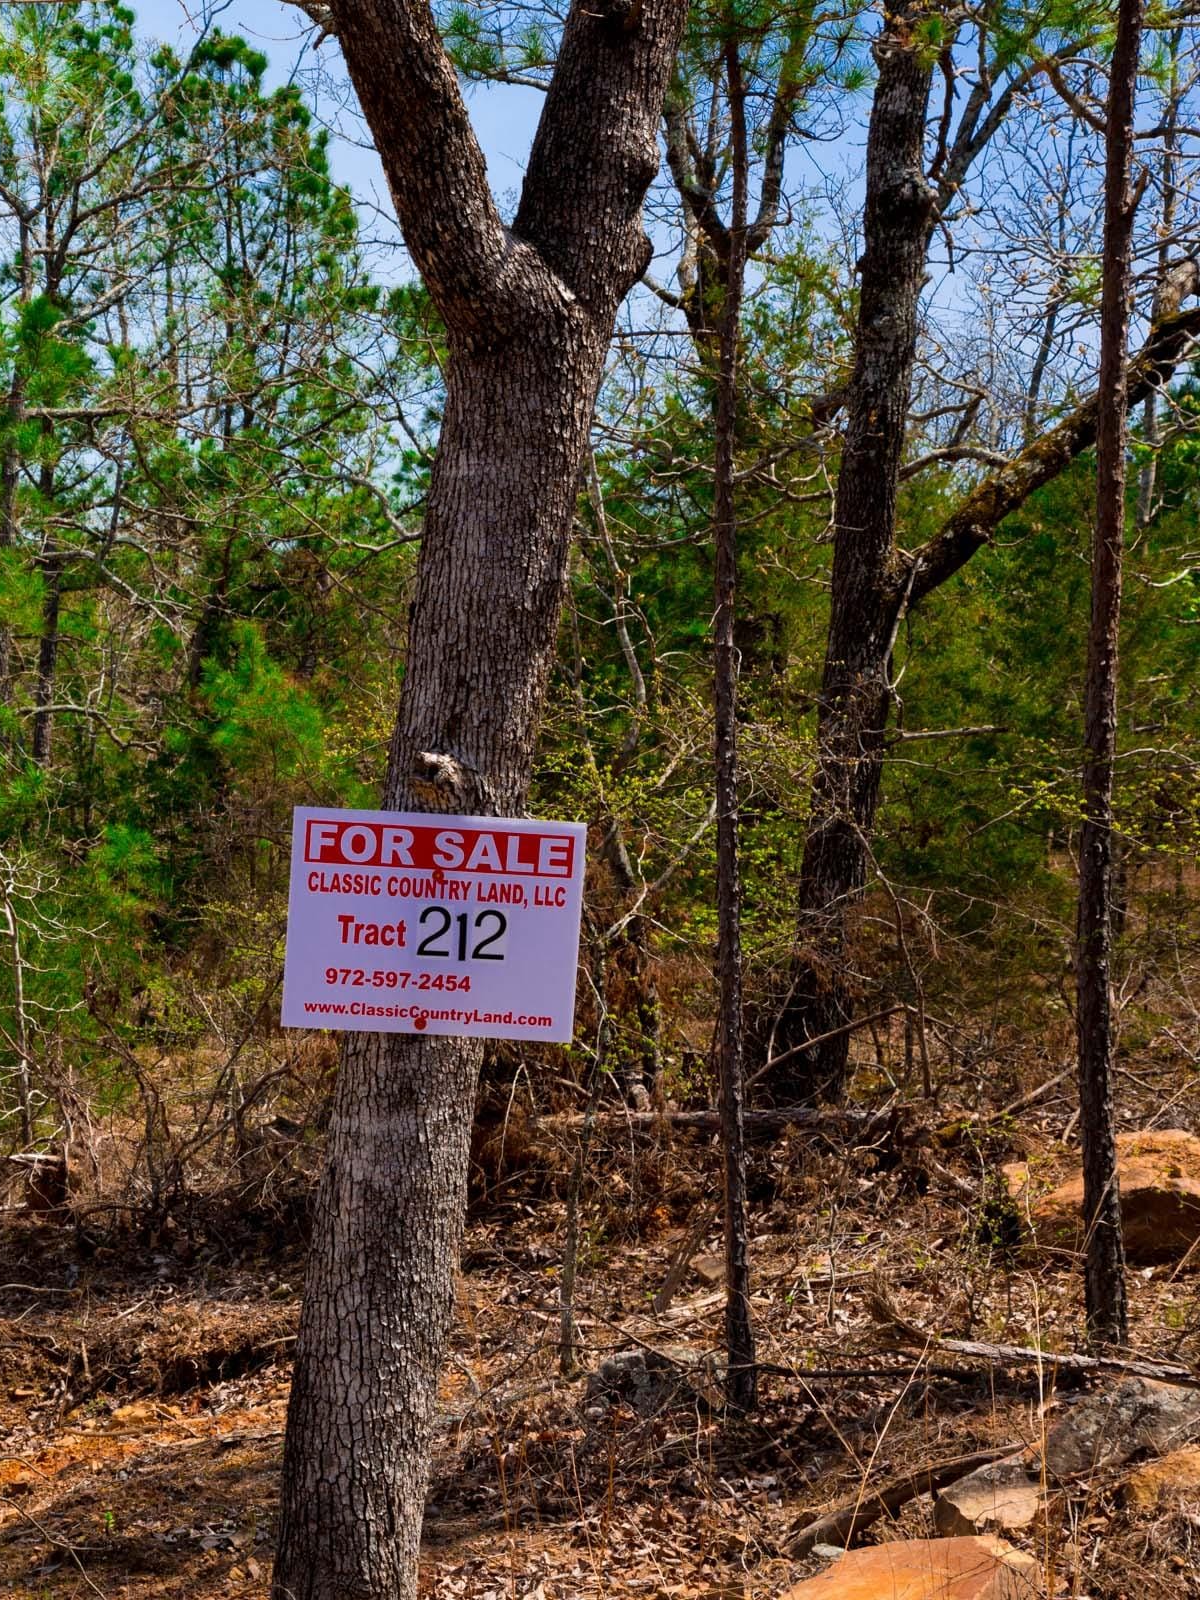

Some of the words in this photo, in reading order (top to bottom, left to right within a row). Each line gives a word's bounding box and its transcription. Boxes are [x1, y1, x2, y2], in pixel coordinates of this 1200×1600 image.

[308, 823, 415, 866] FOR
[432, 831, 570, 875] SALE
[308, 871, 382, 896] CLASSIC
[387, 875, 472, 901] COUNTRY
[477, 881, 528, 908] LAND,
[534, 886, 566, 907] LLC
[338, 914, 407, 947] Tract
[416, 906, 508, 961] 212
[325, 968, 471, 993] 972-597-2454
[304, 1001, 553, 1028] www.ClassicCountryLand.com
